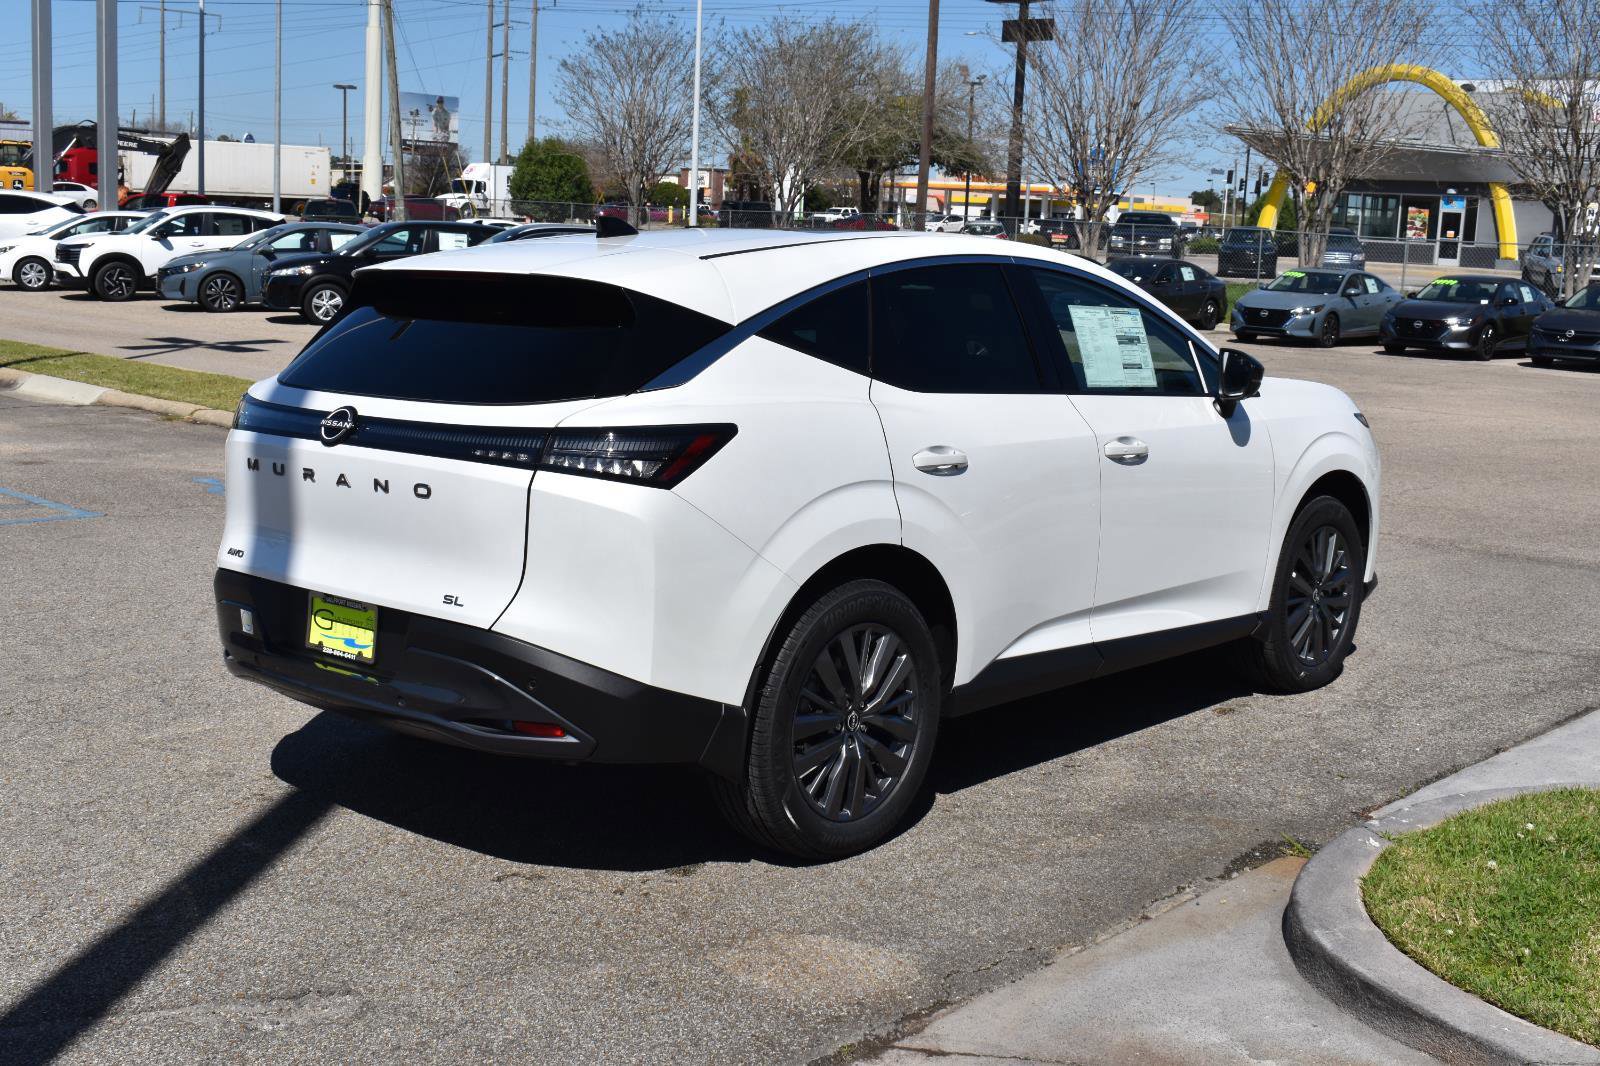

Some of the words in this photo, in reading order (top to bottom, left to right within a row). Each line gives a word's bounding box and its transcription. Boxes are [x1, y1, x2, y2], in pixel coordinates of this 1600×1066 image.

[320, 419, 353, 429] NISSAN
[247, 458, 432, 499] MURANO
[227, 547, 245, 558] AWD
[442, 594, 464, 607] SL
